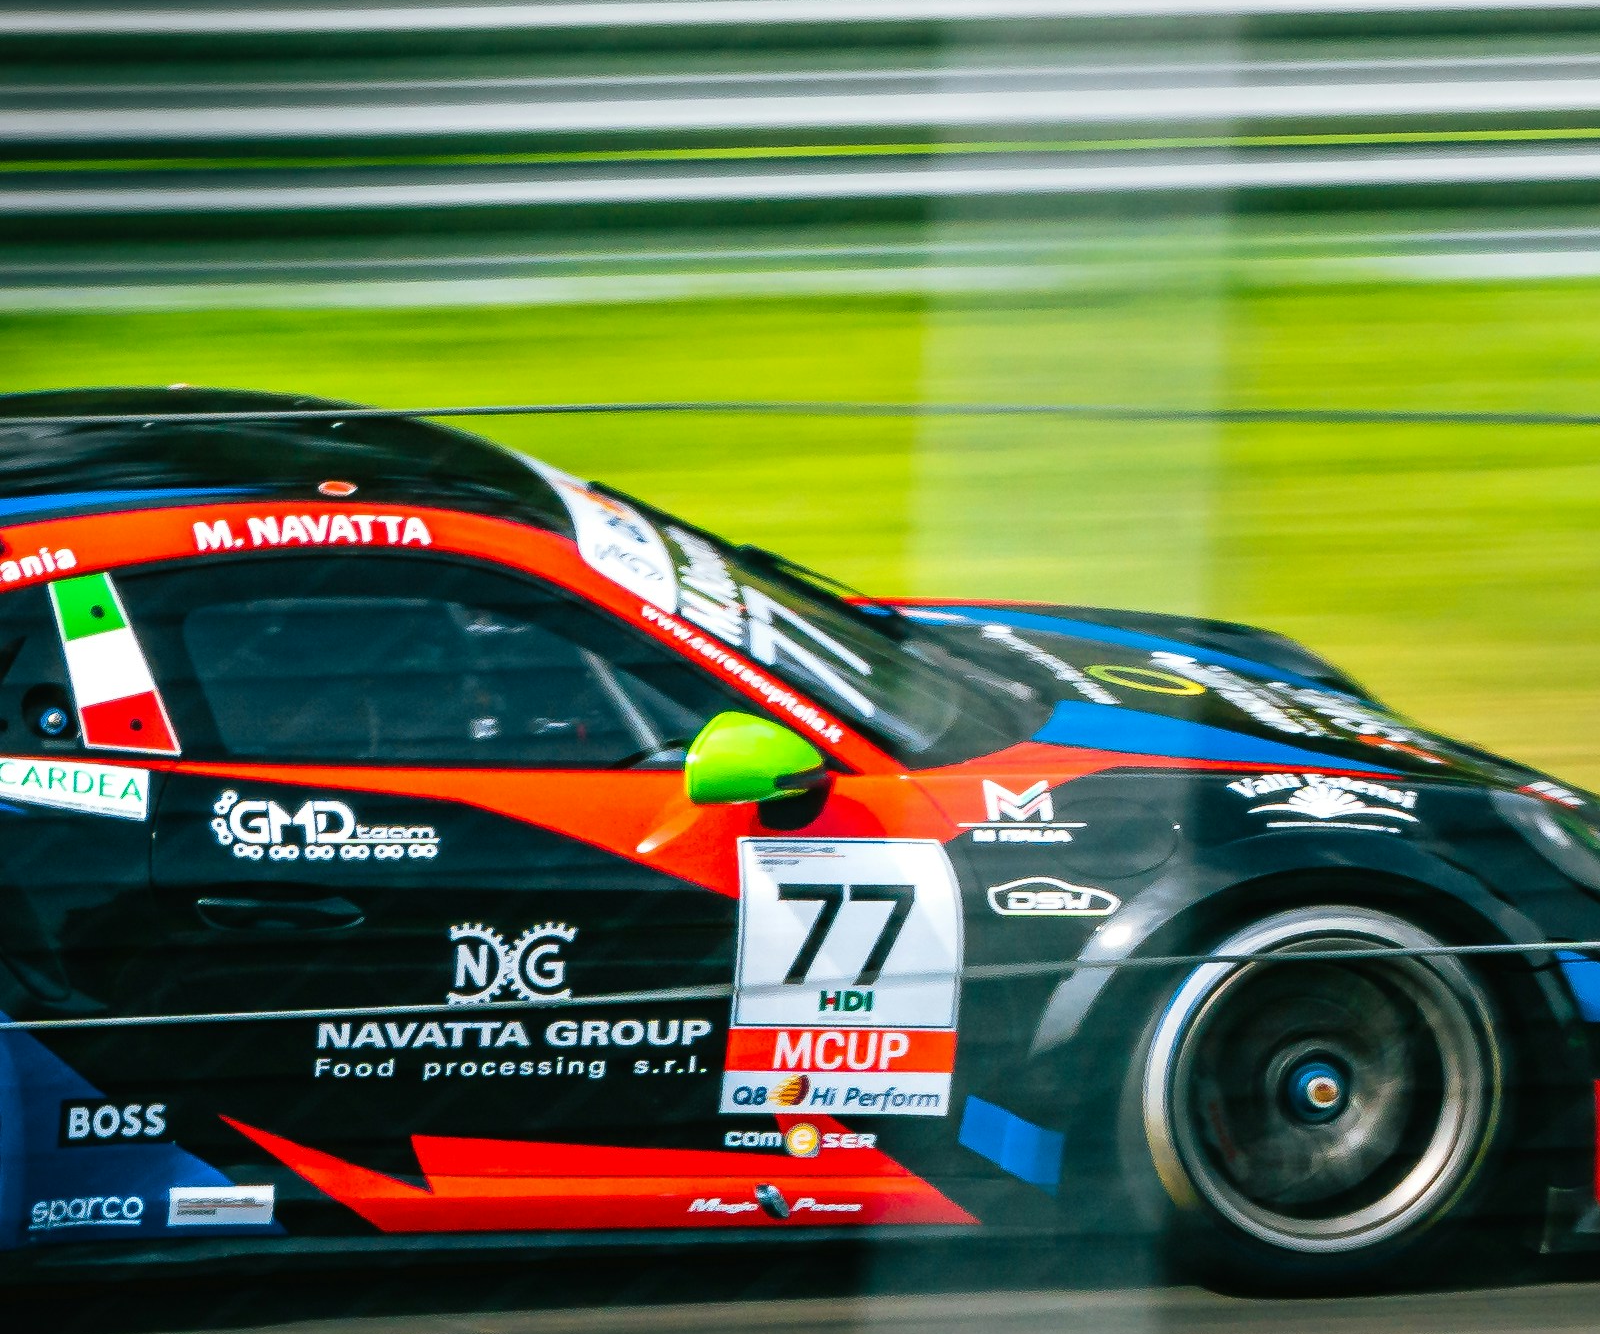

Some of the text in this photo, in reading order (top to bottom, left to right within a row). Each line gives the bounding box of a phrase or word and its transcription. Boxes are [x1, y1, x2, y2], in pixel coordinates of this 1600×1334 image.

[193, 514, 433, 551] M. NAVATTA
[0, 546, 78, 583] ania
[0, 760, 143, 803] CARDEA
[229, 800, 357, 845] GMD
[777, 883, 916, 986] 77
[817, 990, 875, 1013] HDI
[316, 1019, 712, 1049] NAVATTA GROUP
[772, 1031, 910, 1071] MCUP
[314, 1054, 708, 1082] Food processing s.r.l.
[731, 1085, 941, 1112] Q8 Hi Perform
[67, 1102, 167, 1140] BOSS
[30, 1196, 144, 1230] sparco
